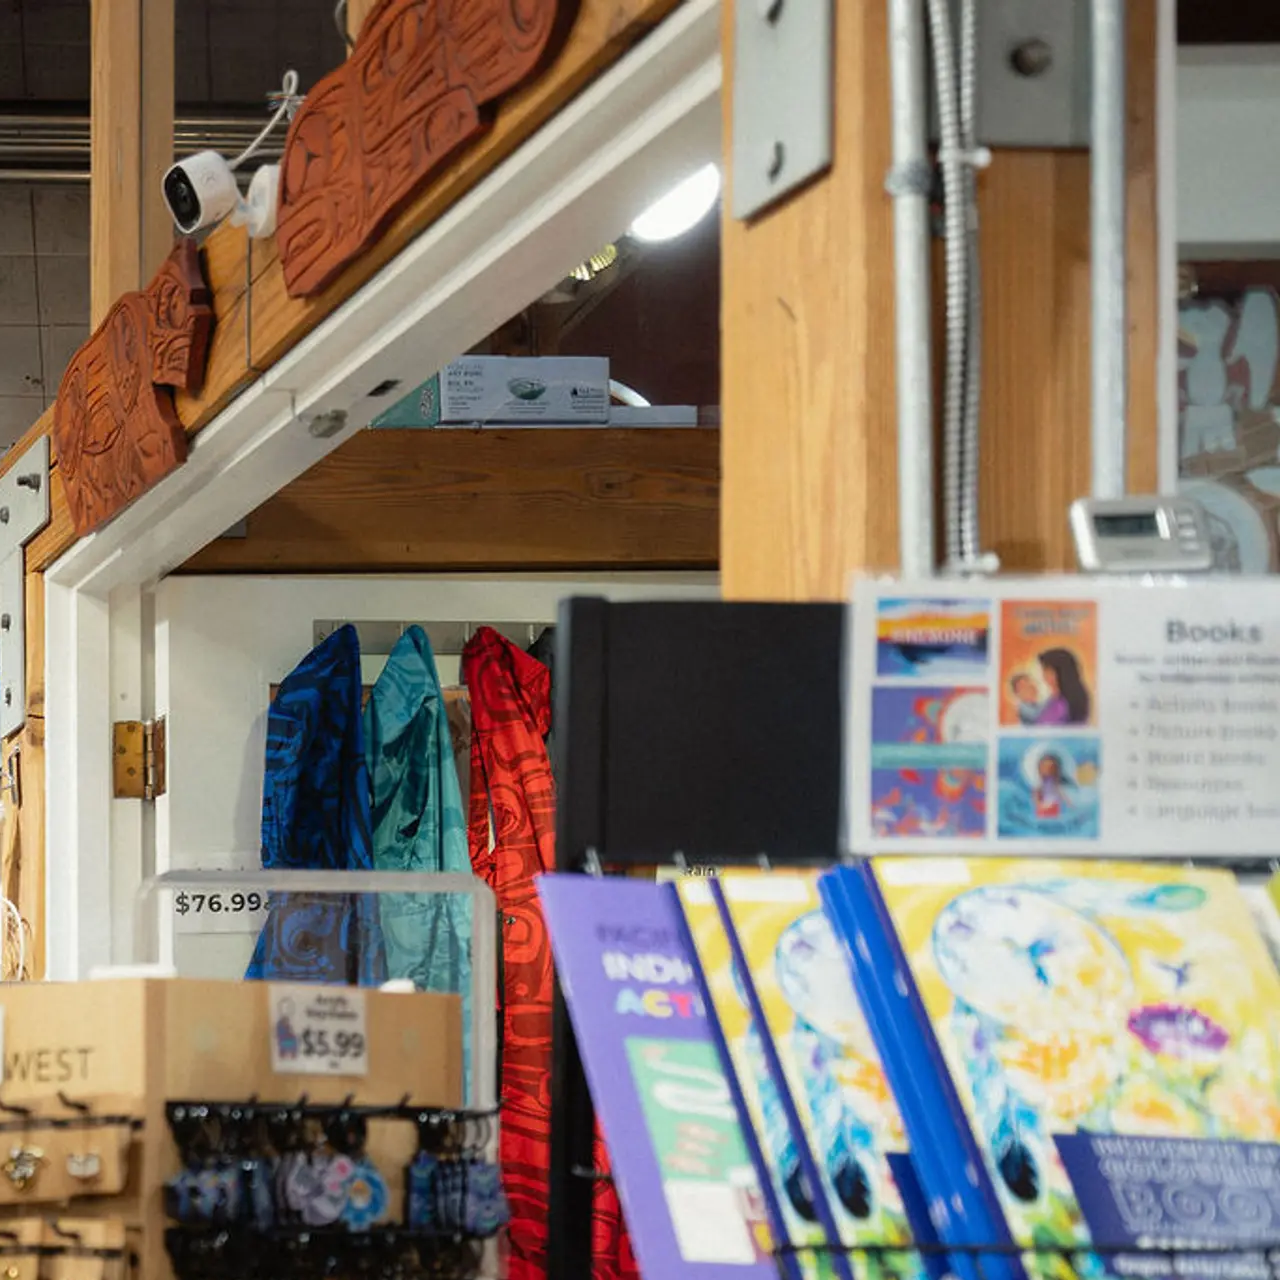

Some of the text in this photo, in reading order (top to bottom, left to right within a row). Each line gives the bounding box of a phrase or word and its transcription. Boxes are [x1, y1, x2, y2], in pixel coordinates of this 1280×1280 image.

[1166, 619, 1263, 645] Books
[175, 892, 261, 916] $76.99
[301, 1027, 365, 1058] $5.99
